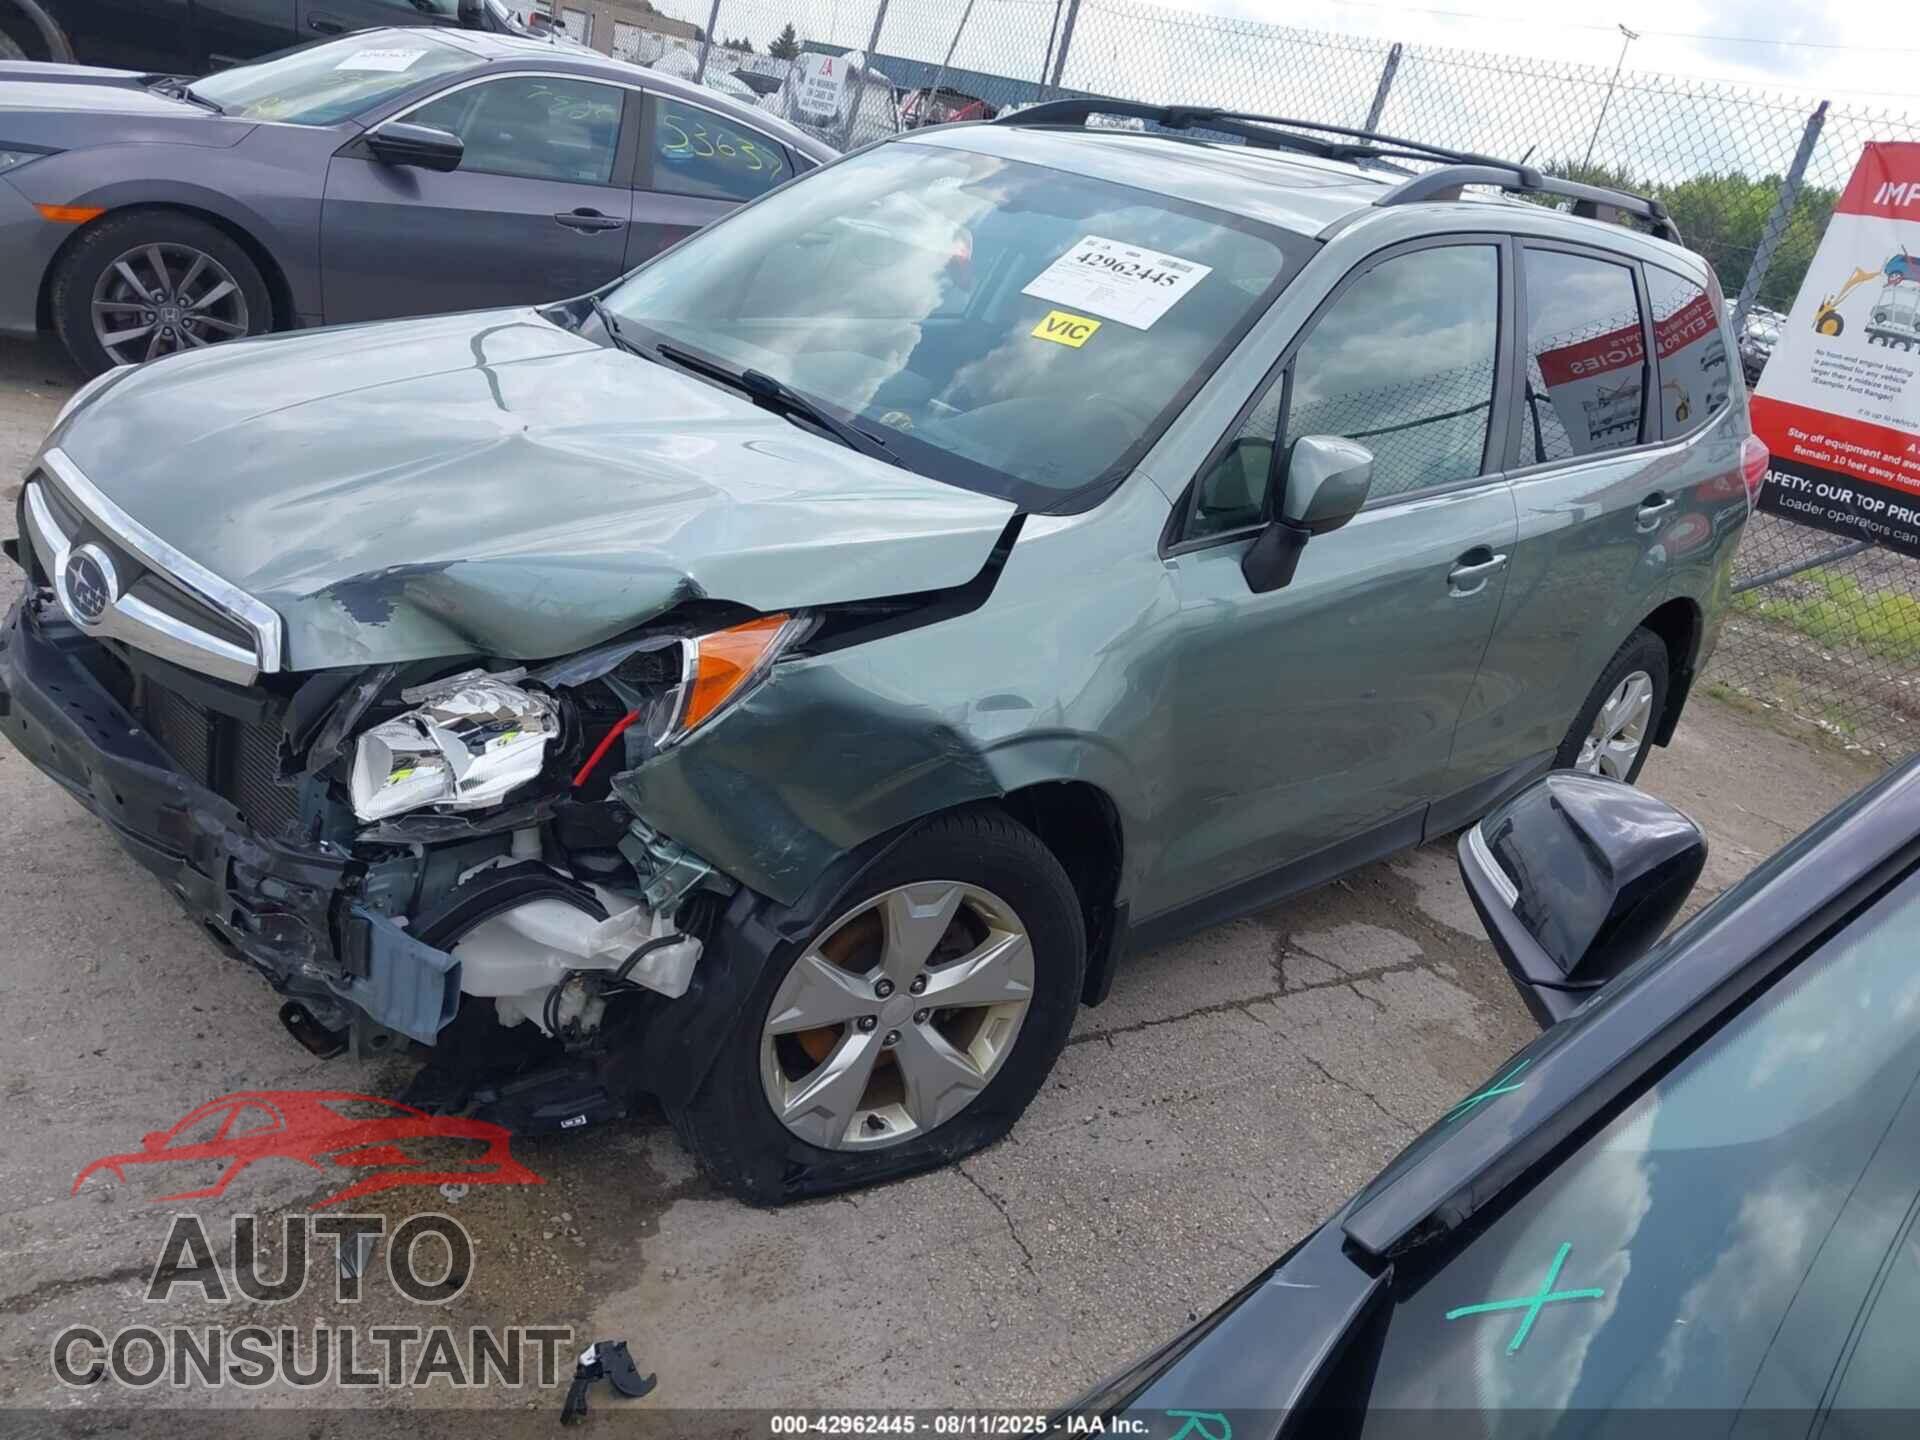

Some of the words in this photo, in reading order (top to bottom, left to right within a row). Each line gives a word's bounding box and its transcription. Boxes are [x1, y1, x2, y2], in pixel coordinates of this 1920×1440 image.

[1076, 251, 1180, 288] 42962445
[1046, 316, 1090, 340] VIC
[1788, 427, 1809, 442] Stay
[1810, 433, 1824, 445] off
[1825, 438, 1882, 459] equipment
[1882, 452, 1902, 465] and
[1794, 444, 1831, 461] Remain
[1833, 454, 1847, 465] 10
[1848, 458, 1867, 472] feet
[1868, 464, 1897, 481] away
[1764, 469, 1814, 494] AFETY:
[1816, 483, 1854, 503] OUR
[1856, 493, 1886, 512] TOP
[1779, 493, 1825, 516] Loader
[1827, 509, 1891, 536] operators
[1893, 530, 1919, 545] can
